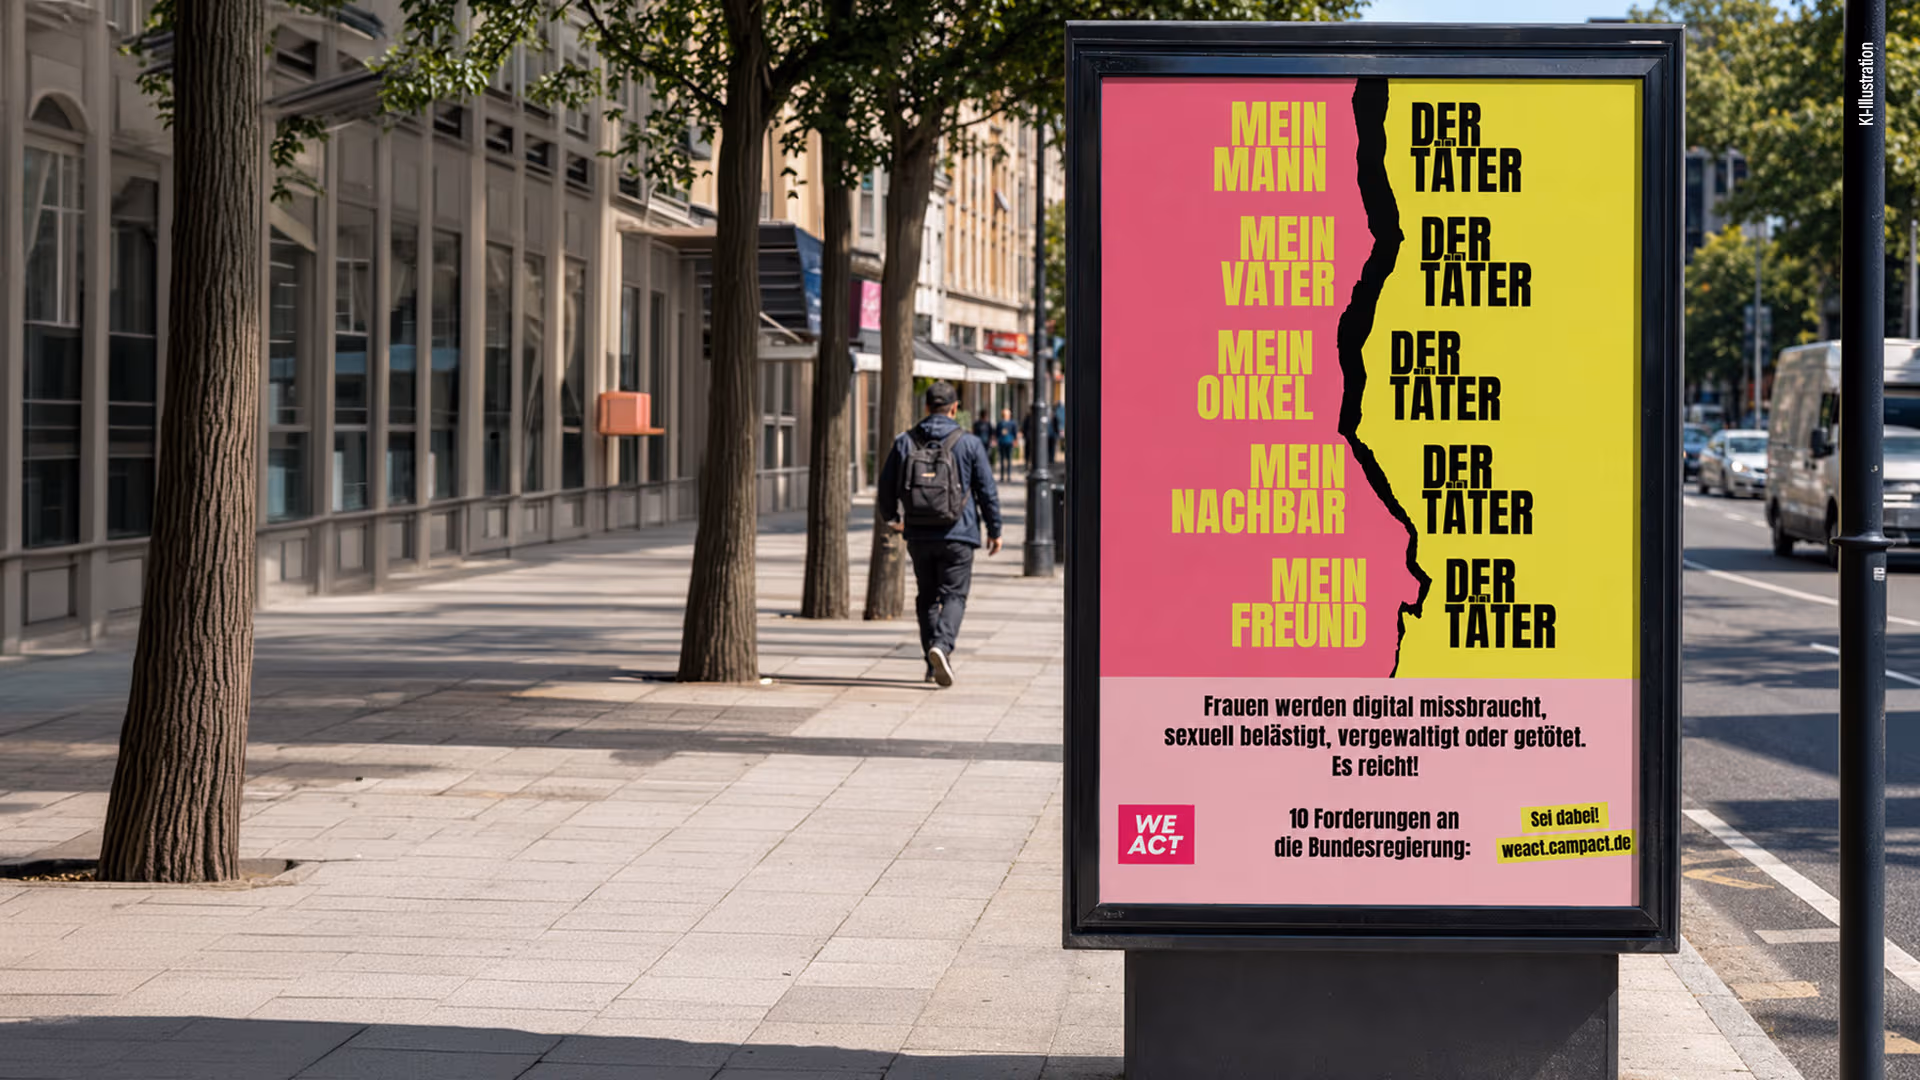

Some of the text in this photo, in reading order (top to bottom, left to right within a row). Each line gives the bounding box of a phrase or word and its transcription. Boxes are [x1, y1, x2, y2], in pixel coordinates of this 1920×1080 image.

[1232, 101, 1326, 146] MEIN
[1412, 102, 1481, 146] DER
[1214, 147, 1326, 191] MANN
[1411, 138, 1521, 192] TÄTER
[1240, 216, 1334, 260] MEIN
[1422, 217, 1490, 261] DER
[1221, 261, 1334, 306] VATER
[1421, 253, 1531, 306] TÄTER
[1218, 330, 1312, 374] MEIN
[1392, 331, 1460, 375] DER
[1198, 375, 1313, 420] ONKEL
[1390, 367, 1500, 420] TÄTER
[1251, 444, 1344, 488] MEIN
[1424, 445, 1492, 489] DER
[1172, 489, 1345, 533] NACHBAR
[1422, 481, 1533, 534] TÄTER
[1272, 558, 1366, 602] MEIN
[1446, 559, 1515, 603] DER
[1232, 603, 1366, 647] FREUND
[1445, 595, 1556, 648] TÄTER
[1204, 695, 1546, 720] Frauen werden digital missbraucht,
[1164, 724, 1586, 749] sexuell belästigt, vergewaltigt oder getötet.
[1332, 755, 1418, 777] Es reicht!
[1136, 815, 1177, 833] WE
[1289, 808, 1459, 831] 10 Forderungen an
[1531, 807, 1599, 827] Sei dabei!
[1275, 836, 1471, 860] die Bundesregierung:
[1502, 834, 1631, 858] weact.campact.de
